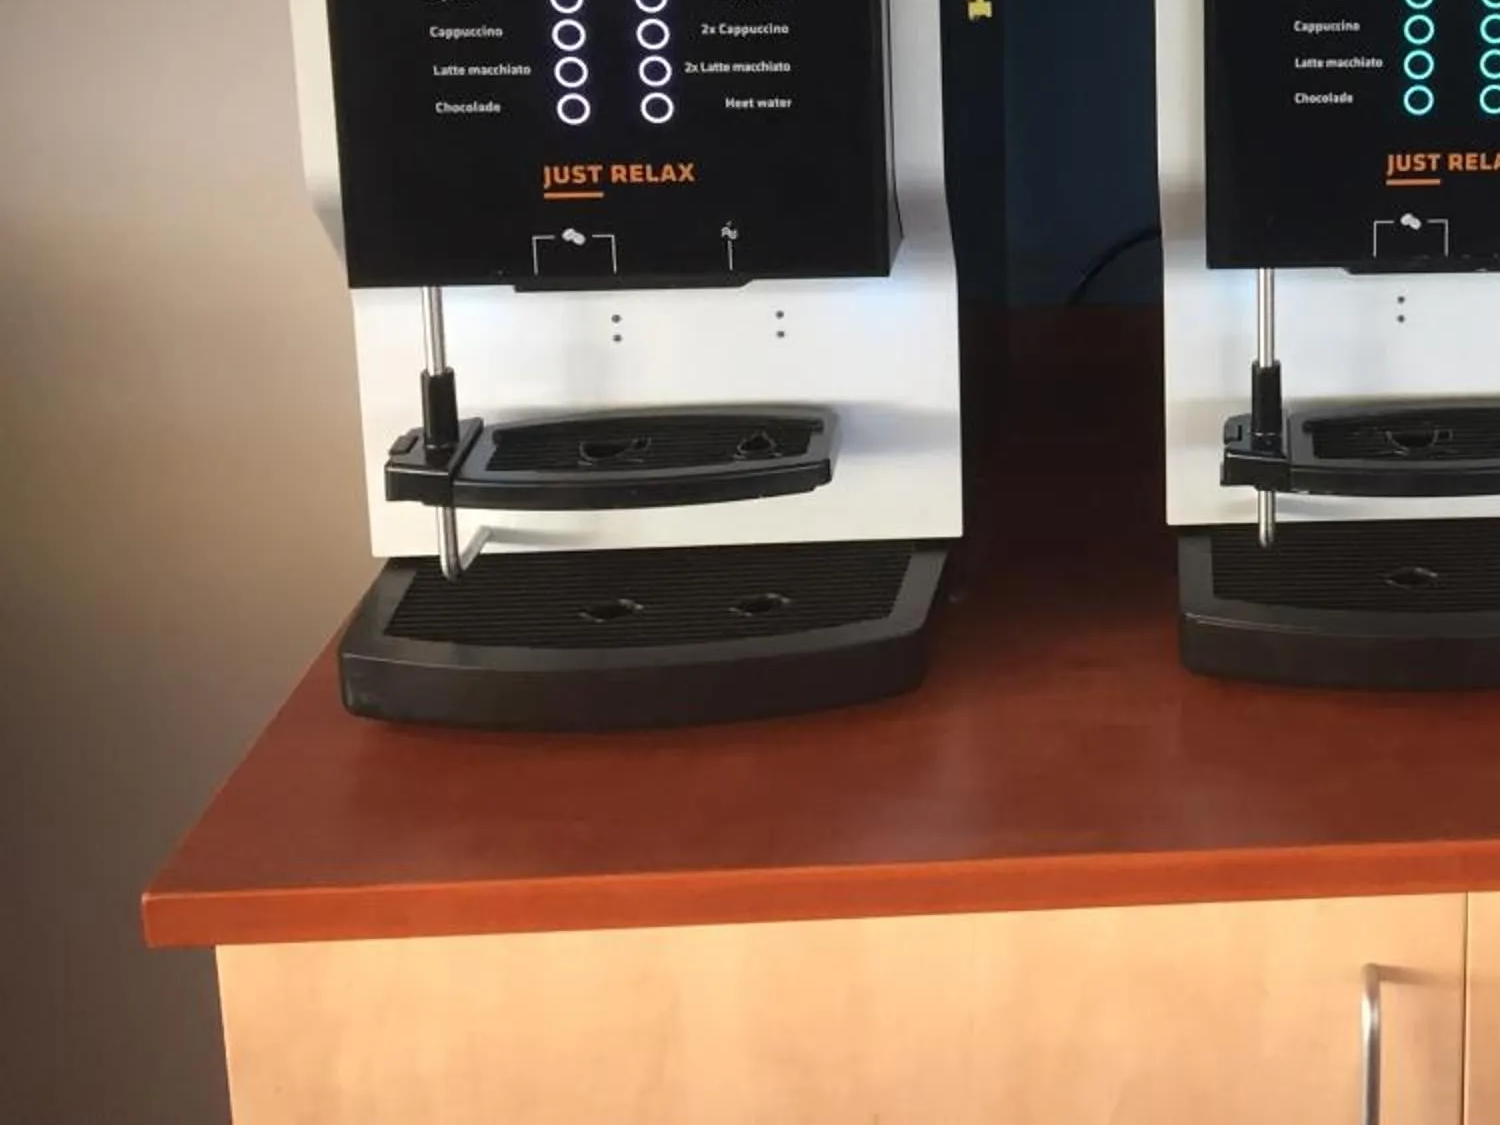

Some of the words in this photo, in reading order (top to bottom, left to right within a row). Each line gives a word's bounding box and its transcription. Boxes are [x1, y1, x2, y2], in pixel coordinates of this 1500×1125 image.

[429, 25, 504, 41] Cappuccino
[700, 23, 717, 36] 2x
[718, 22, 790, 38] Cappuccino
[1293, 19, 1361, 35] Cappuccino
[432, 64, 466, 76] Latte
[467, 62, 532, 76] macchiato
[684, 61, 699, 73] 2x
[700, 60, 731, 73] Latte
[732, 60, 792, 73] macchiato
[1294, 57, 1324, 68] Latte
[1325, 55, 1384, 69] macchiato
[756, 96, 793, 109] water
[1293, 91, 1355, 105] Chocolade
[435, 100, 502, 114] Chocolade
[1385, 153, 1442, 177] JUST
[543, 164, 604, 189] JUST
[609, 162, 697, 183] RELAX
